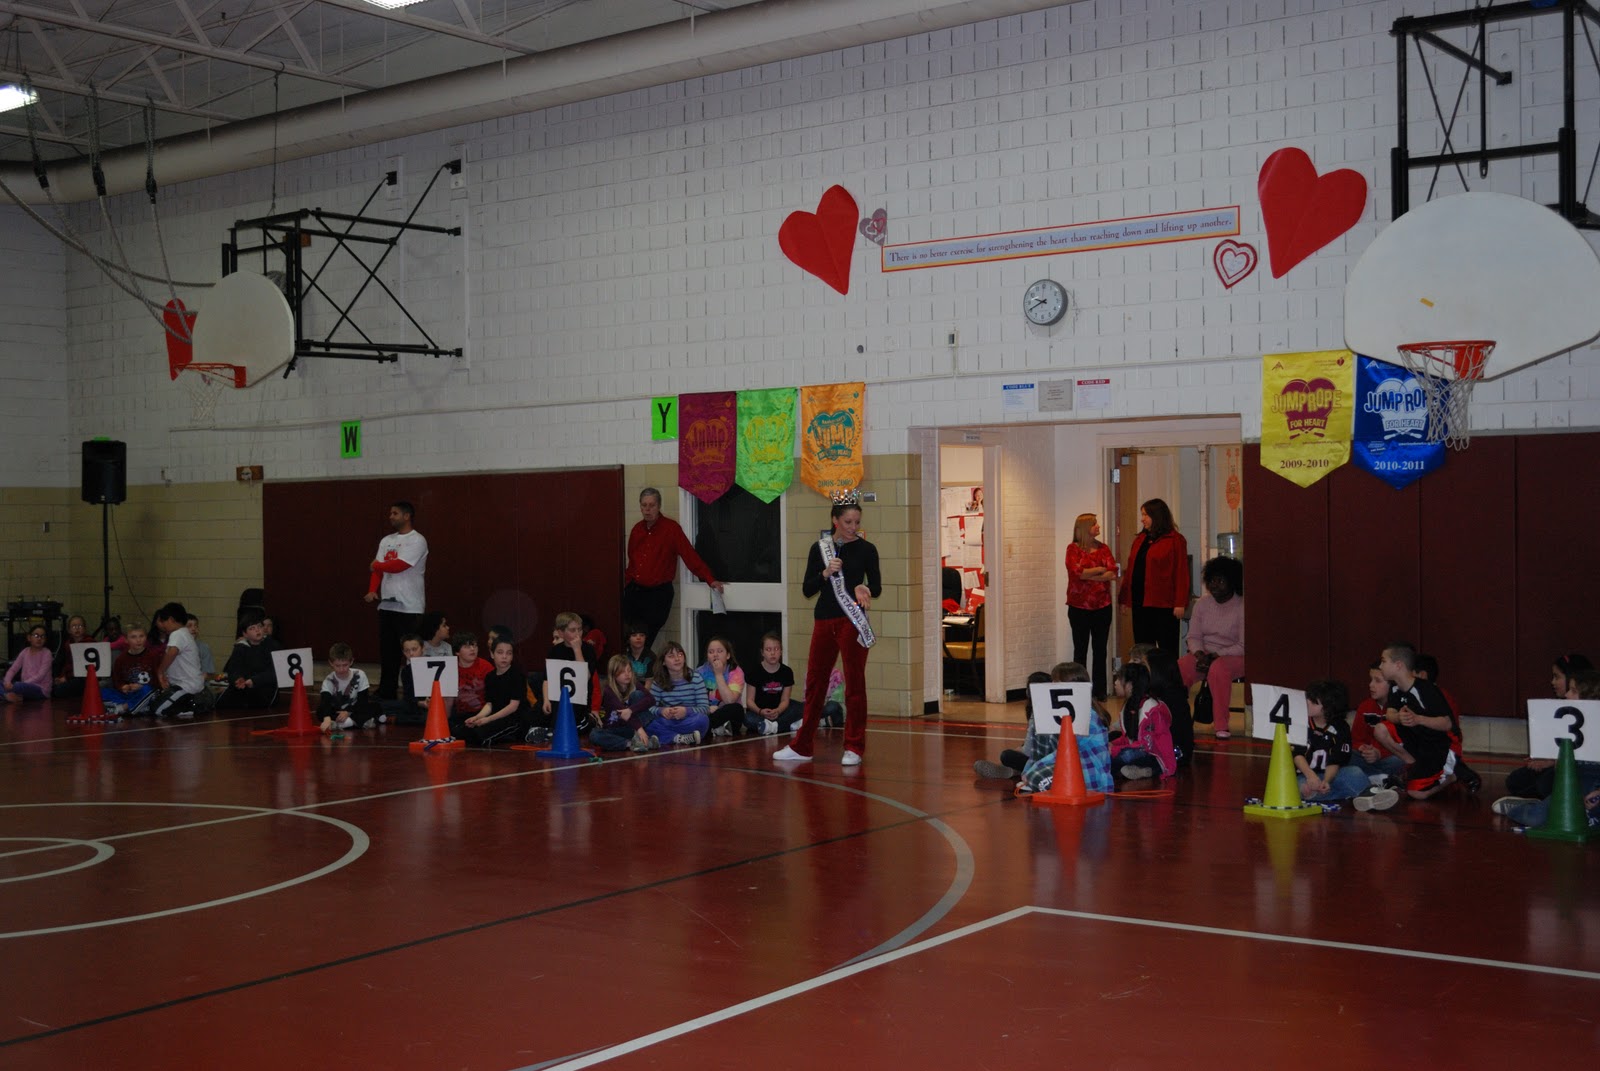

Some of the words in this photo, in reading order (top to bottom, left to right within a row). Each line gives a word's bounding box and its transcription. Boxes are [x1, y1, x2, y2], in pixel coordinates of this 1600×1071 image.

[889, 252, 909, 262] There
[912, 252, 917, 260] is
[930, 249, 948, 258] better
[950, 247, 974, 256] exercise
[976, 243, 986, 253] for
[988, 239, 1034, 252] strengthening
[1036, 236, 1048, 247] the
[1050, 235, 1068, 245] heart
[1070, 233, 1087, 243] than
[1090, 229, 1120, 241] reaching
[1122, 226, 1142, 237] down
[1144, 224, 1158, 235] and
[1161, 222, 1184, 233] lifting
[1187, 222, 1198, 232] up
[1200, 216, 1232, 229] another.
[1271, 391, 1308, 414] JUMP
[1308, 388, 1343, 412] ROPE
[1364, 391, 1402, 414] JUMP
[657, 402, 672, 433] Y
[1289, 418, 1303, 429] FOR
[1303, 417, 1325, 429] HEART
[1385, 418, 1401, 429] FOR
[1401, 418, 1425, 429] HEART
[343, 425, 358, 453] W
[1279, 459, 1330, 469] 2009-2010
[1373, 460, 1425, 471] 2010-2011
[84, 647, 101, 672] 9
[286, 653, 304, 680] 8
[426, 660, 446, 682] 7
[559, 667, 577, 698] 6
[1049, 688, 1076, 725] 5
[1269, 693, 1292, 734] 4
[1553, 706, 1585, 749] 3
[1340, 743, 1350, 753] 10
